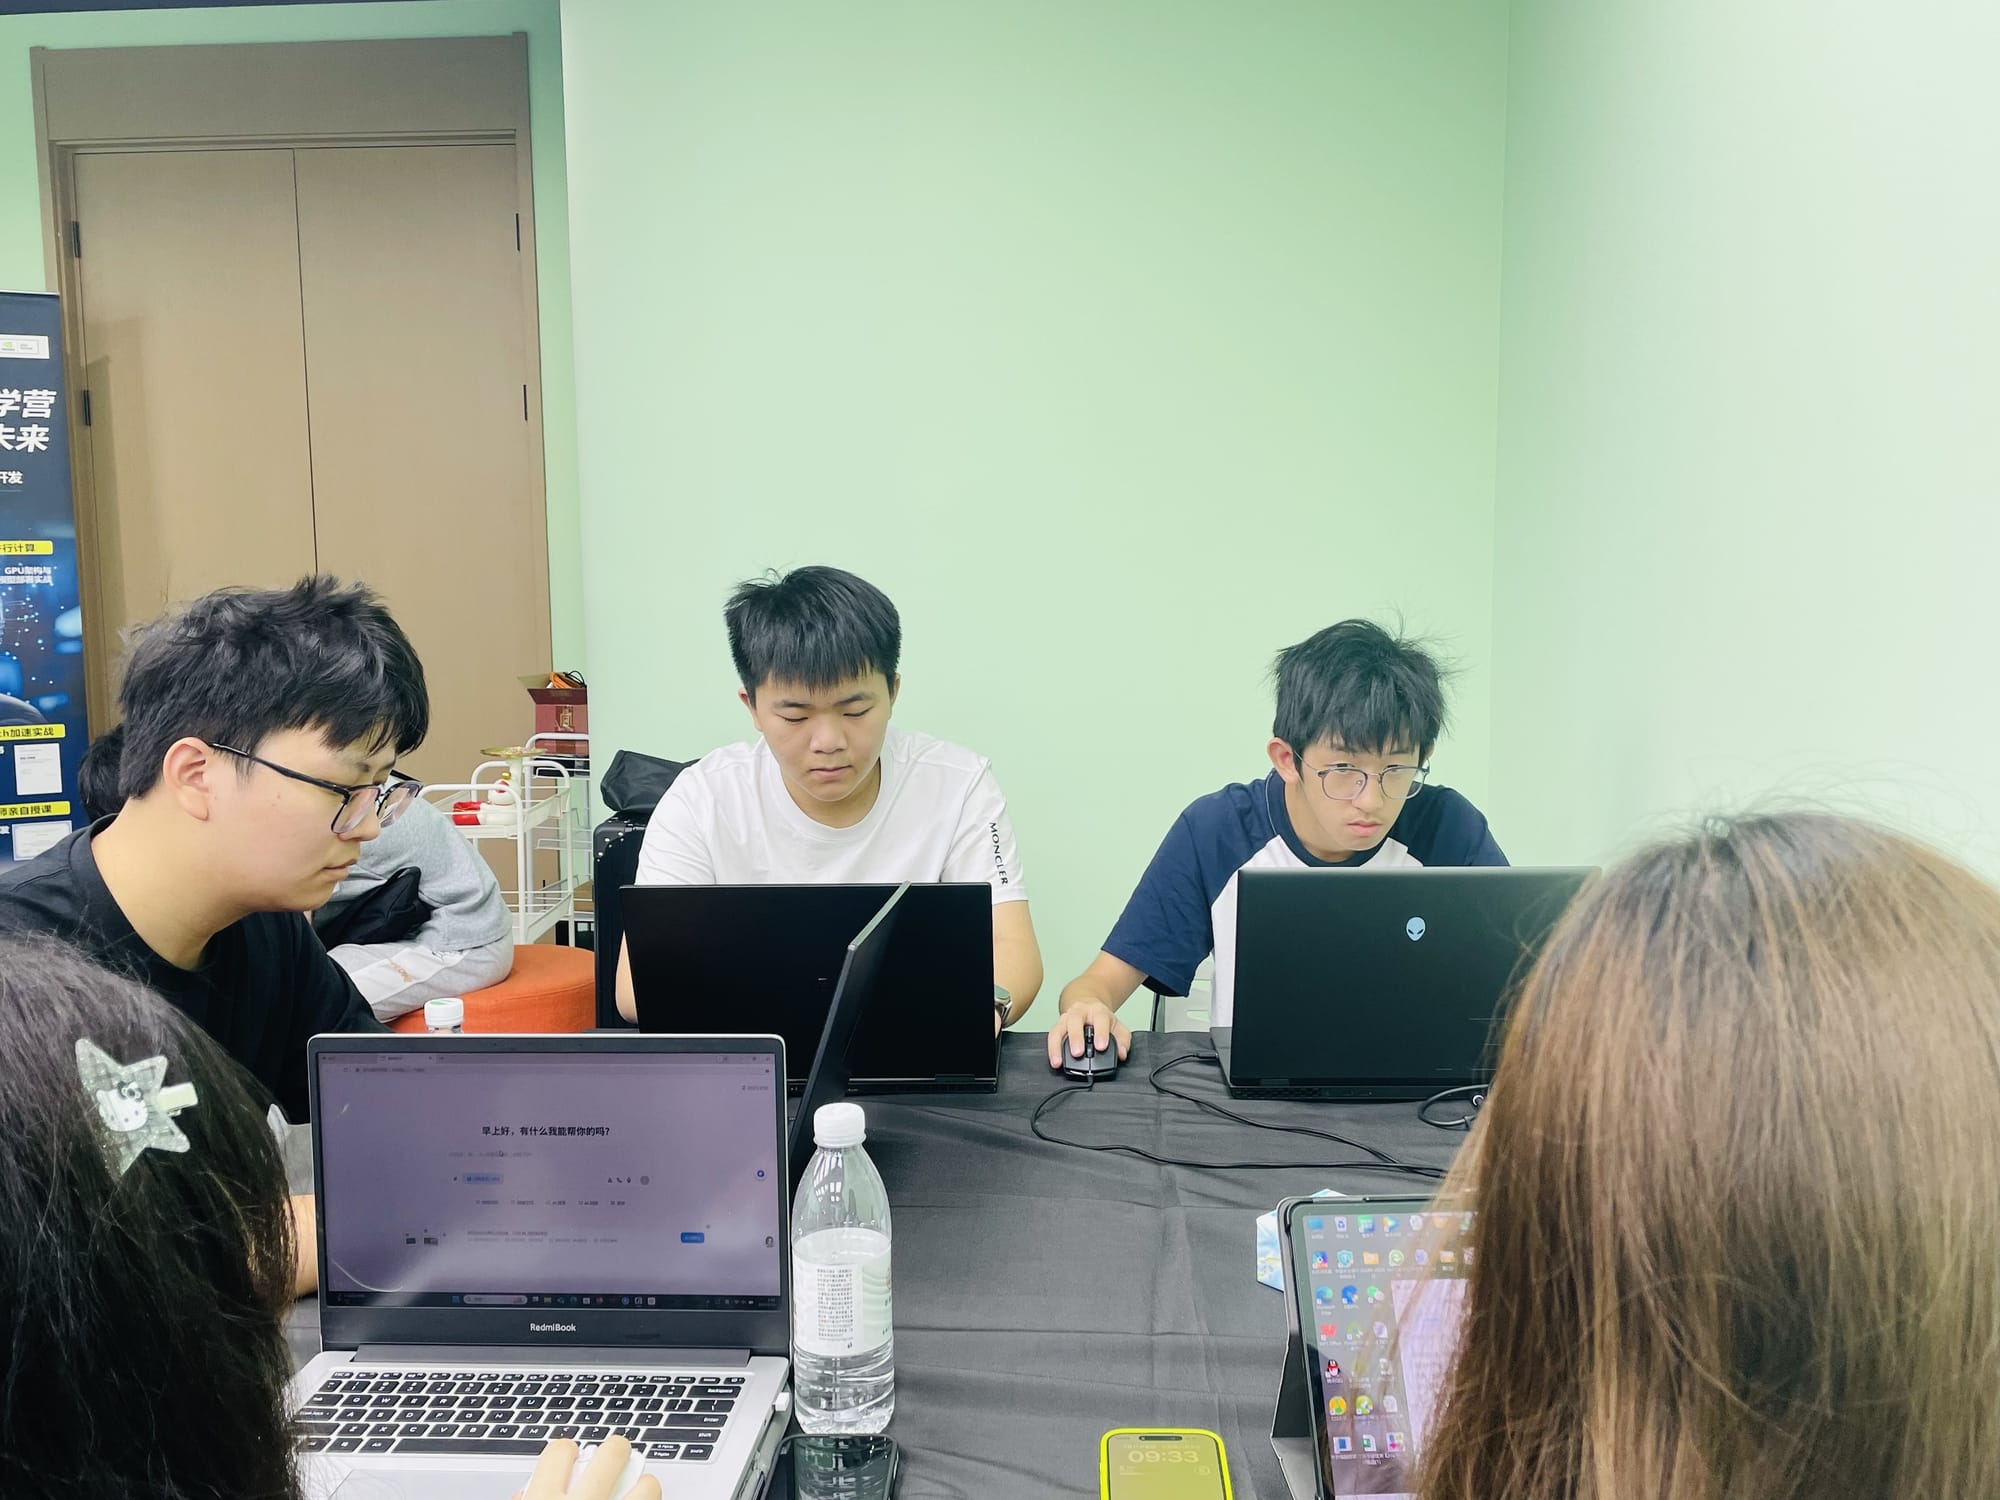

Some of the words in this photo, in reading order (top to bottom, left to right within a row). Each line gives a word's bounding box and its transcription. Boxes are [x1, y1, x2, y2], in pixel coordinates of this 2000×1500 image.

[0, 388, 57, 418] 学营
[0, 543, 35, 553] 行计算
[989, 822, 1008, 885] MONCLER
[530, 1322, 577, 1331] RedmiBook
[1128, 1451, 1199, 1463] 09:33
